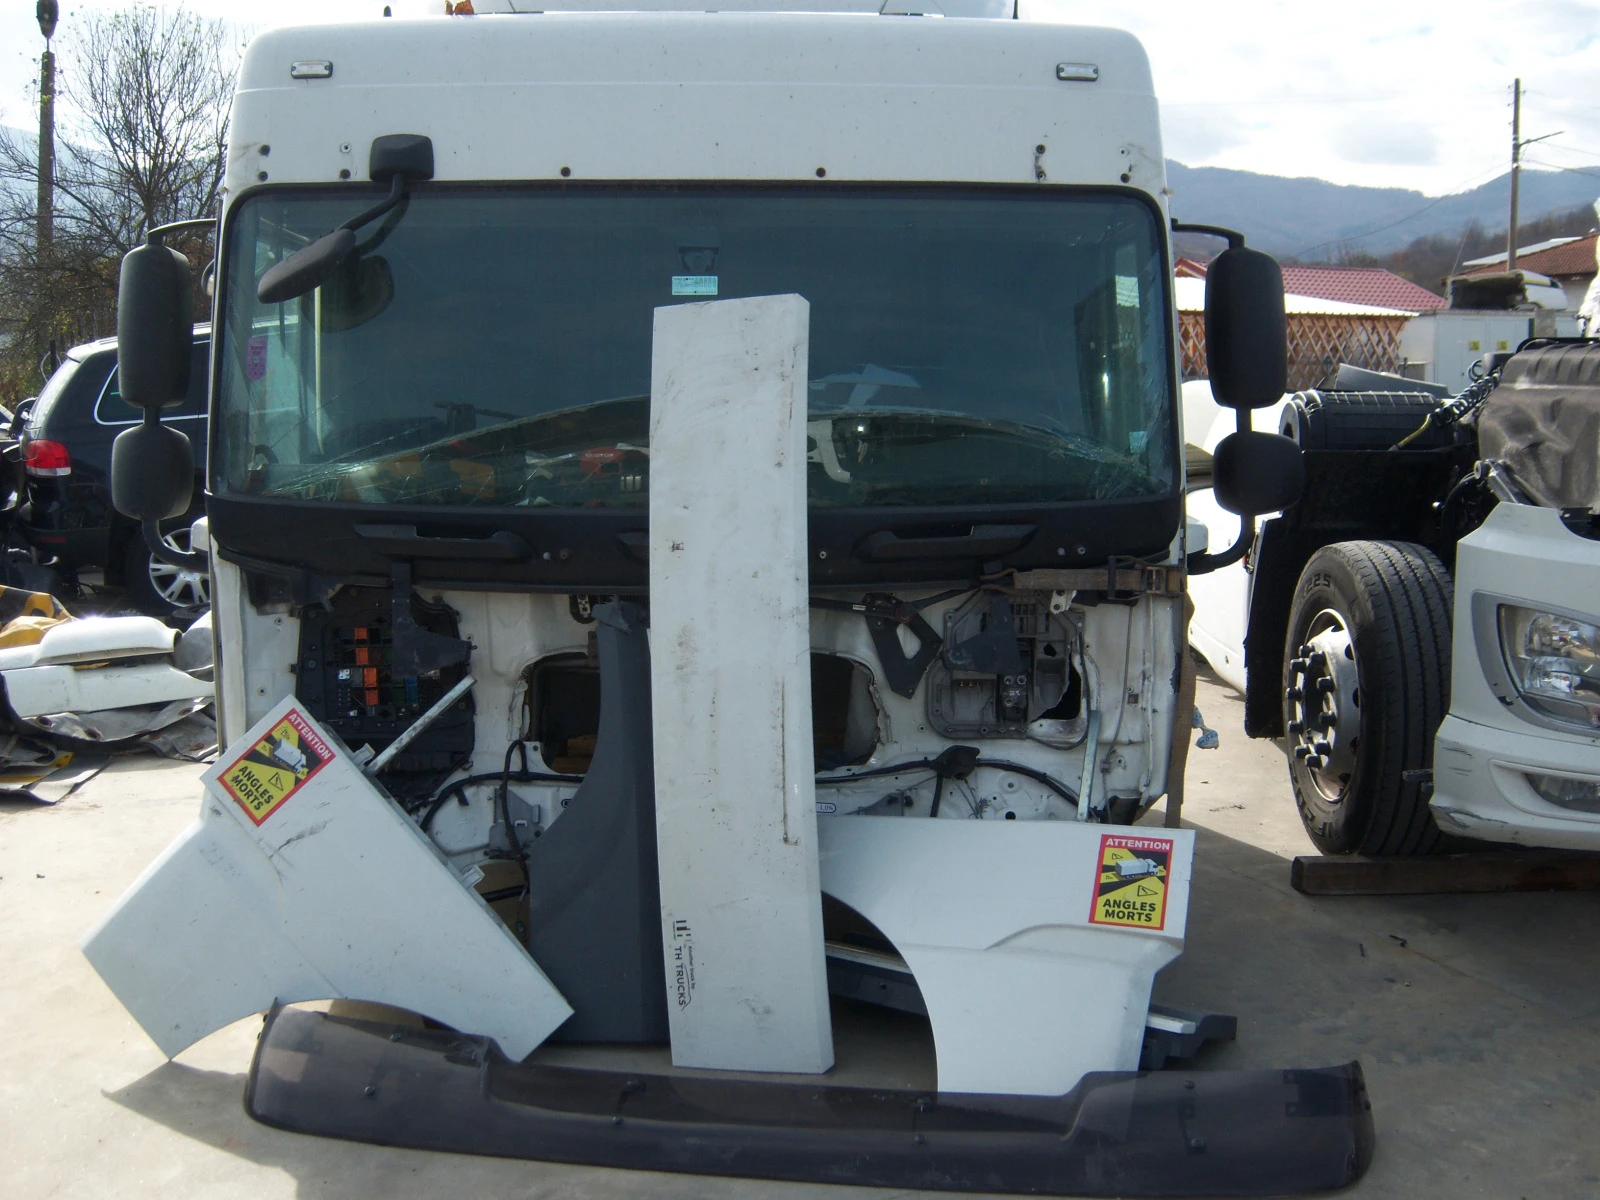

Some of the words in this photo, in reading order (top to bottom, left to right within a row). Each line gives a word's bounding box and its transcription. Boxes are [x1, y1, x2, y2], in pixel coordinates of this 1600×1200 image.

[289, 713, 331, 760] ATTENTION
[231, 775, 264, 811] MORTS
[238, 765, 274, 804] ANGLES
[1105, 838, 1171, 850] ATTENTION
[1103, 898, 1156, 912] ANGLES
[1104, 909, 1153, 922] MORTS
[674, 945, 683, 960] TH
[676, 963, 686, 1006] TRUCKS
